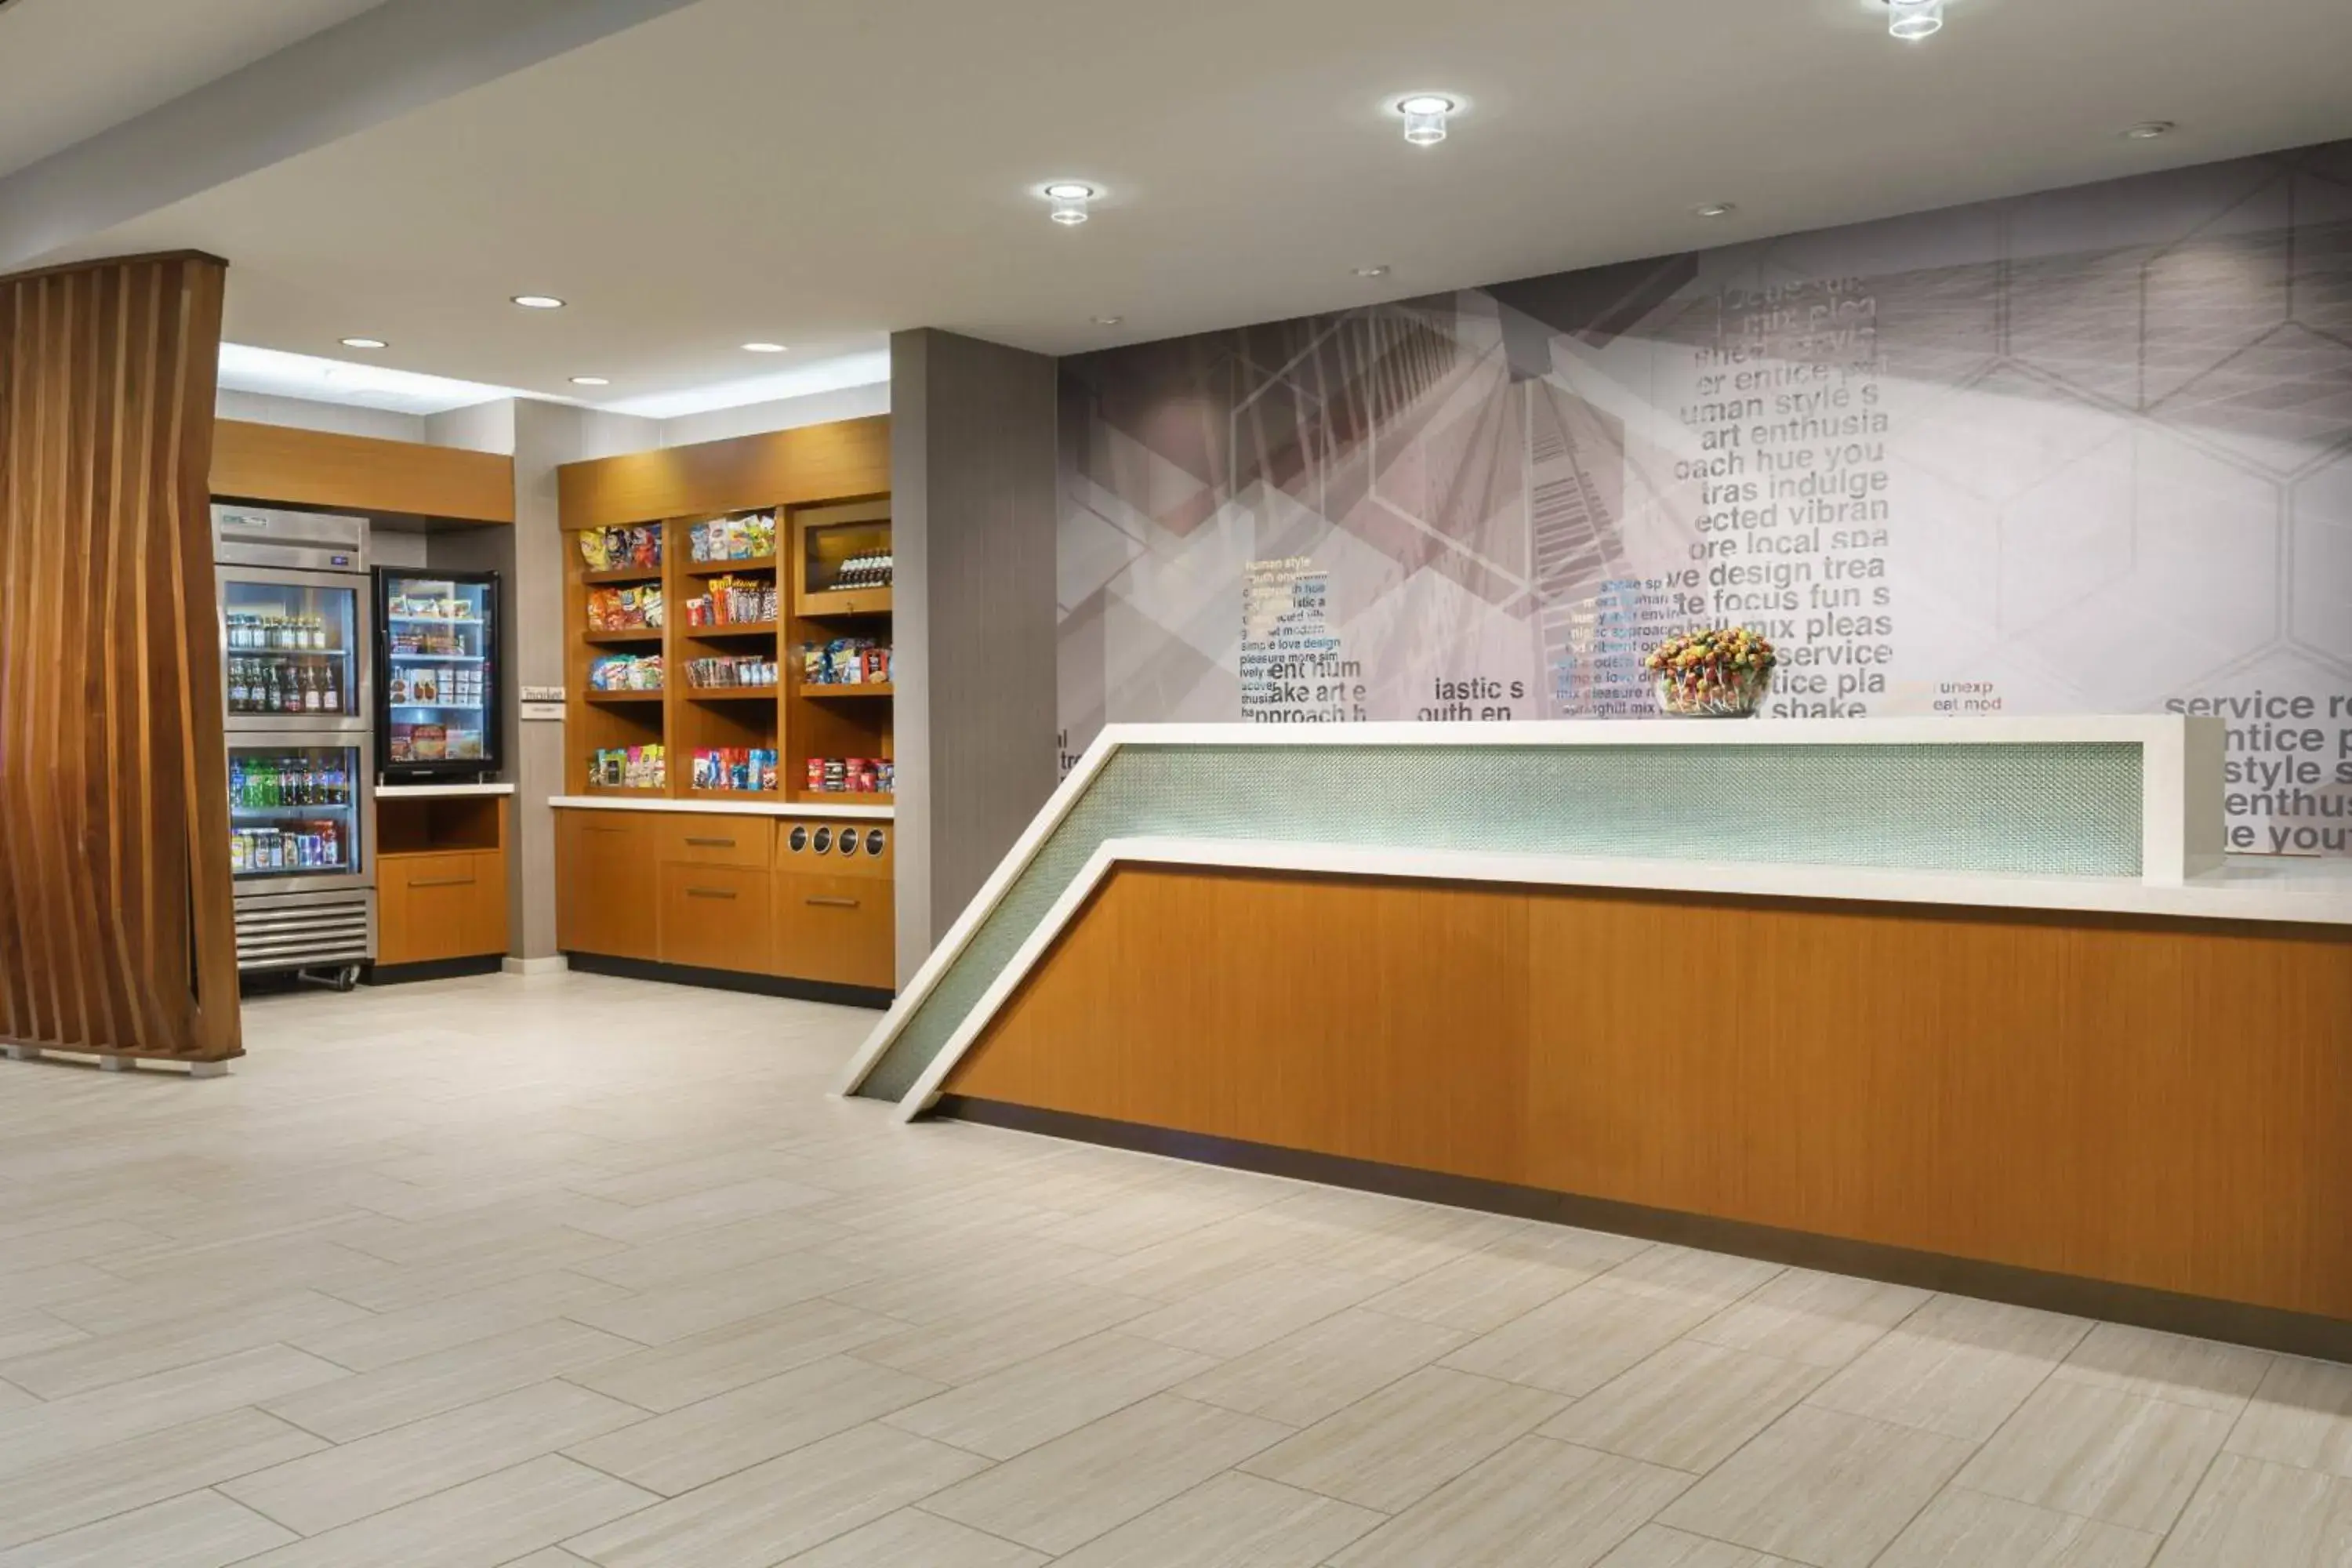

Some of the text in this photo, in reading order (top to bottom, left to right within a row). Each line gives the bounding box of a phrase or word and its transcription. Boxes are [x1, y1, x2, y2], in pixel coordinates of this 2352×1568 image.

[1751, 408, 1889, 445] enthusia
[1756, 448, 1813, 472] hue
[1769, 470, 1889, 500] indulge
[1694, 498, 1889, 532] ected vibran
[1689, 537, 1737, 561] ore
[1708, 561, 1812, 589] design
[1823, 555, 1886, 581] trea
[1713, 589, 1799, 614] focus
[1809, 583, 1861, 609] fun
[1872, 585, 1891, 606] s
[1806, 612, 1894, 644] pleas
[1775, 639, 1892, 666] service
[1272, 682, 1367, 702] ake art e
[1435, 677, 1524, 699] iastic s
[1772, 668, 1886, 700] tice pla
[1940, 682, 1994, 696] unexp
[1481, 706, 1512, 721] en
[1772, 697, 1867, 718] shake
[1964, 696, 2002, 711] mod
[2165, 689, 2315, 719] service
[2225, 722, 2325, 752] ntice
[2225, 754, 2321, 792] style
